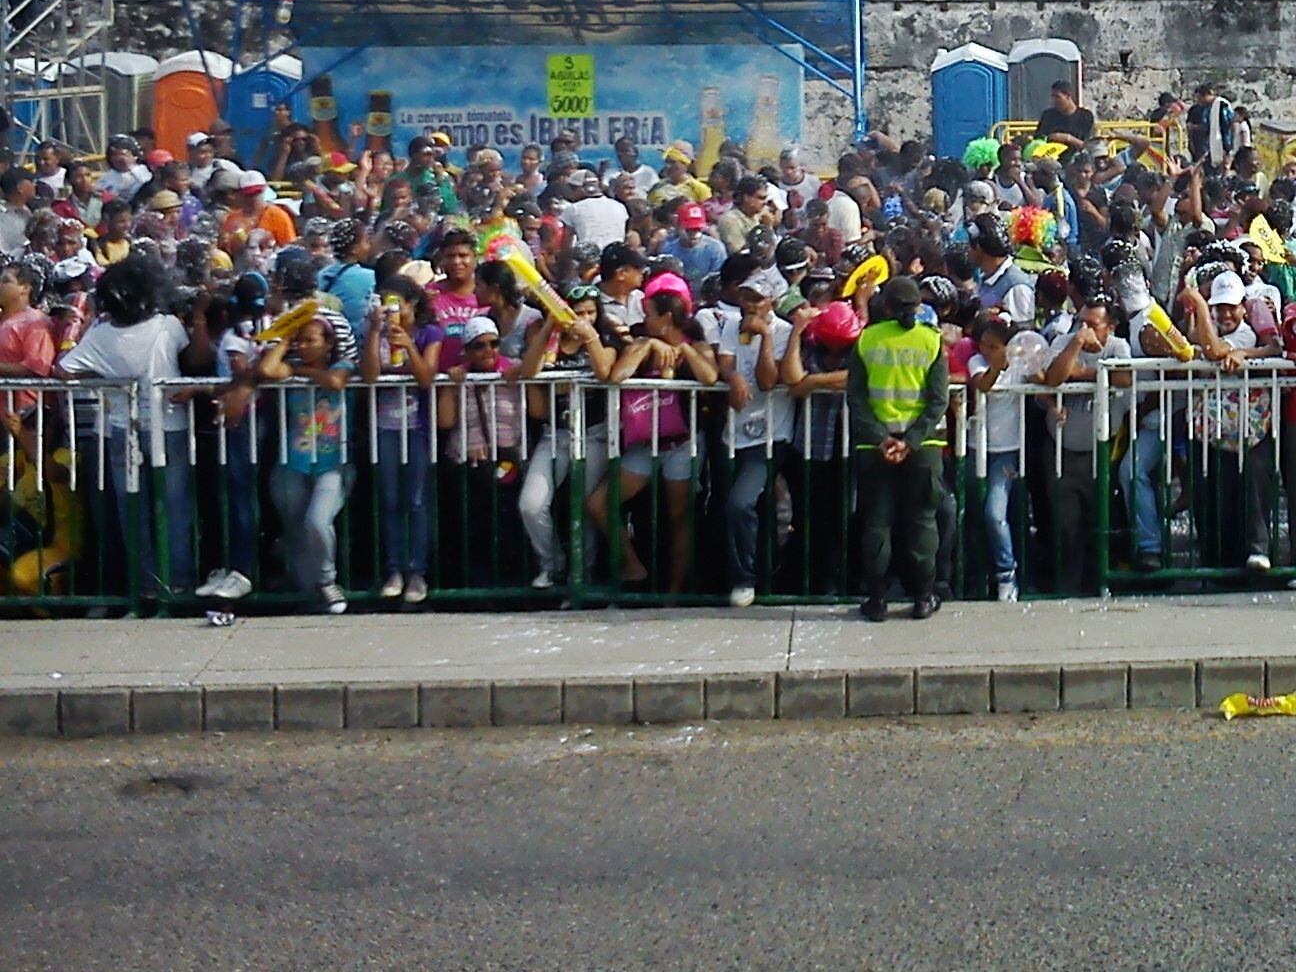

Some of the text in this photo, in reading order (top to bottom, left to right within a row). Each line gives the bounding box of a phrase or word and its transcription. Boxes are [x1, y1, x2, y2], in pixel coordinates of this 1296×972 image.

[564, 56, 574, 70] 3
[417, 114, 463, 123] cerveza
[495, 124, 524, 145] es
